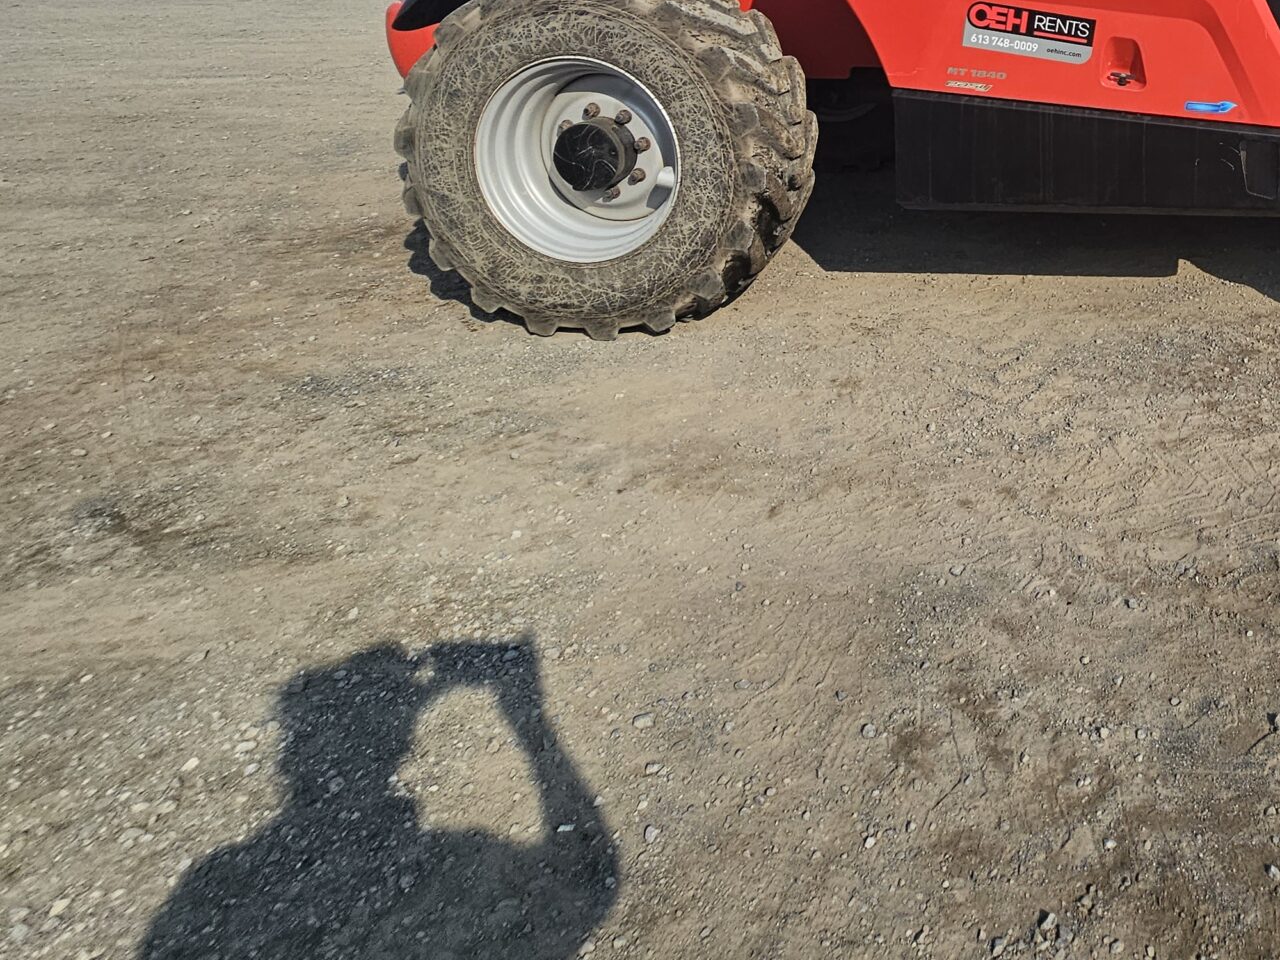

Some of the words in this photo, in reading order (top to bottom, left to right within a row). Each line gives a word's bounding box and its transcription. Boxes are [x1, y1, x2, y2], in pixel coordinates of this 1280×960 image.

[969, 3, 1029, 33] OEH
[1034, 15, 1089, 37] RENTS
[970, 34, 990, 45] 613
[992, 37, 1039, 52] 748-0009
[1046, 47, 1082, 58] oehinc.com
[970, 69, 1007, 80] 1840
